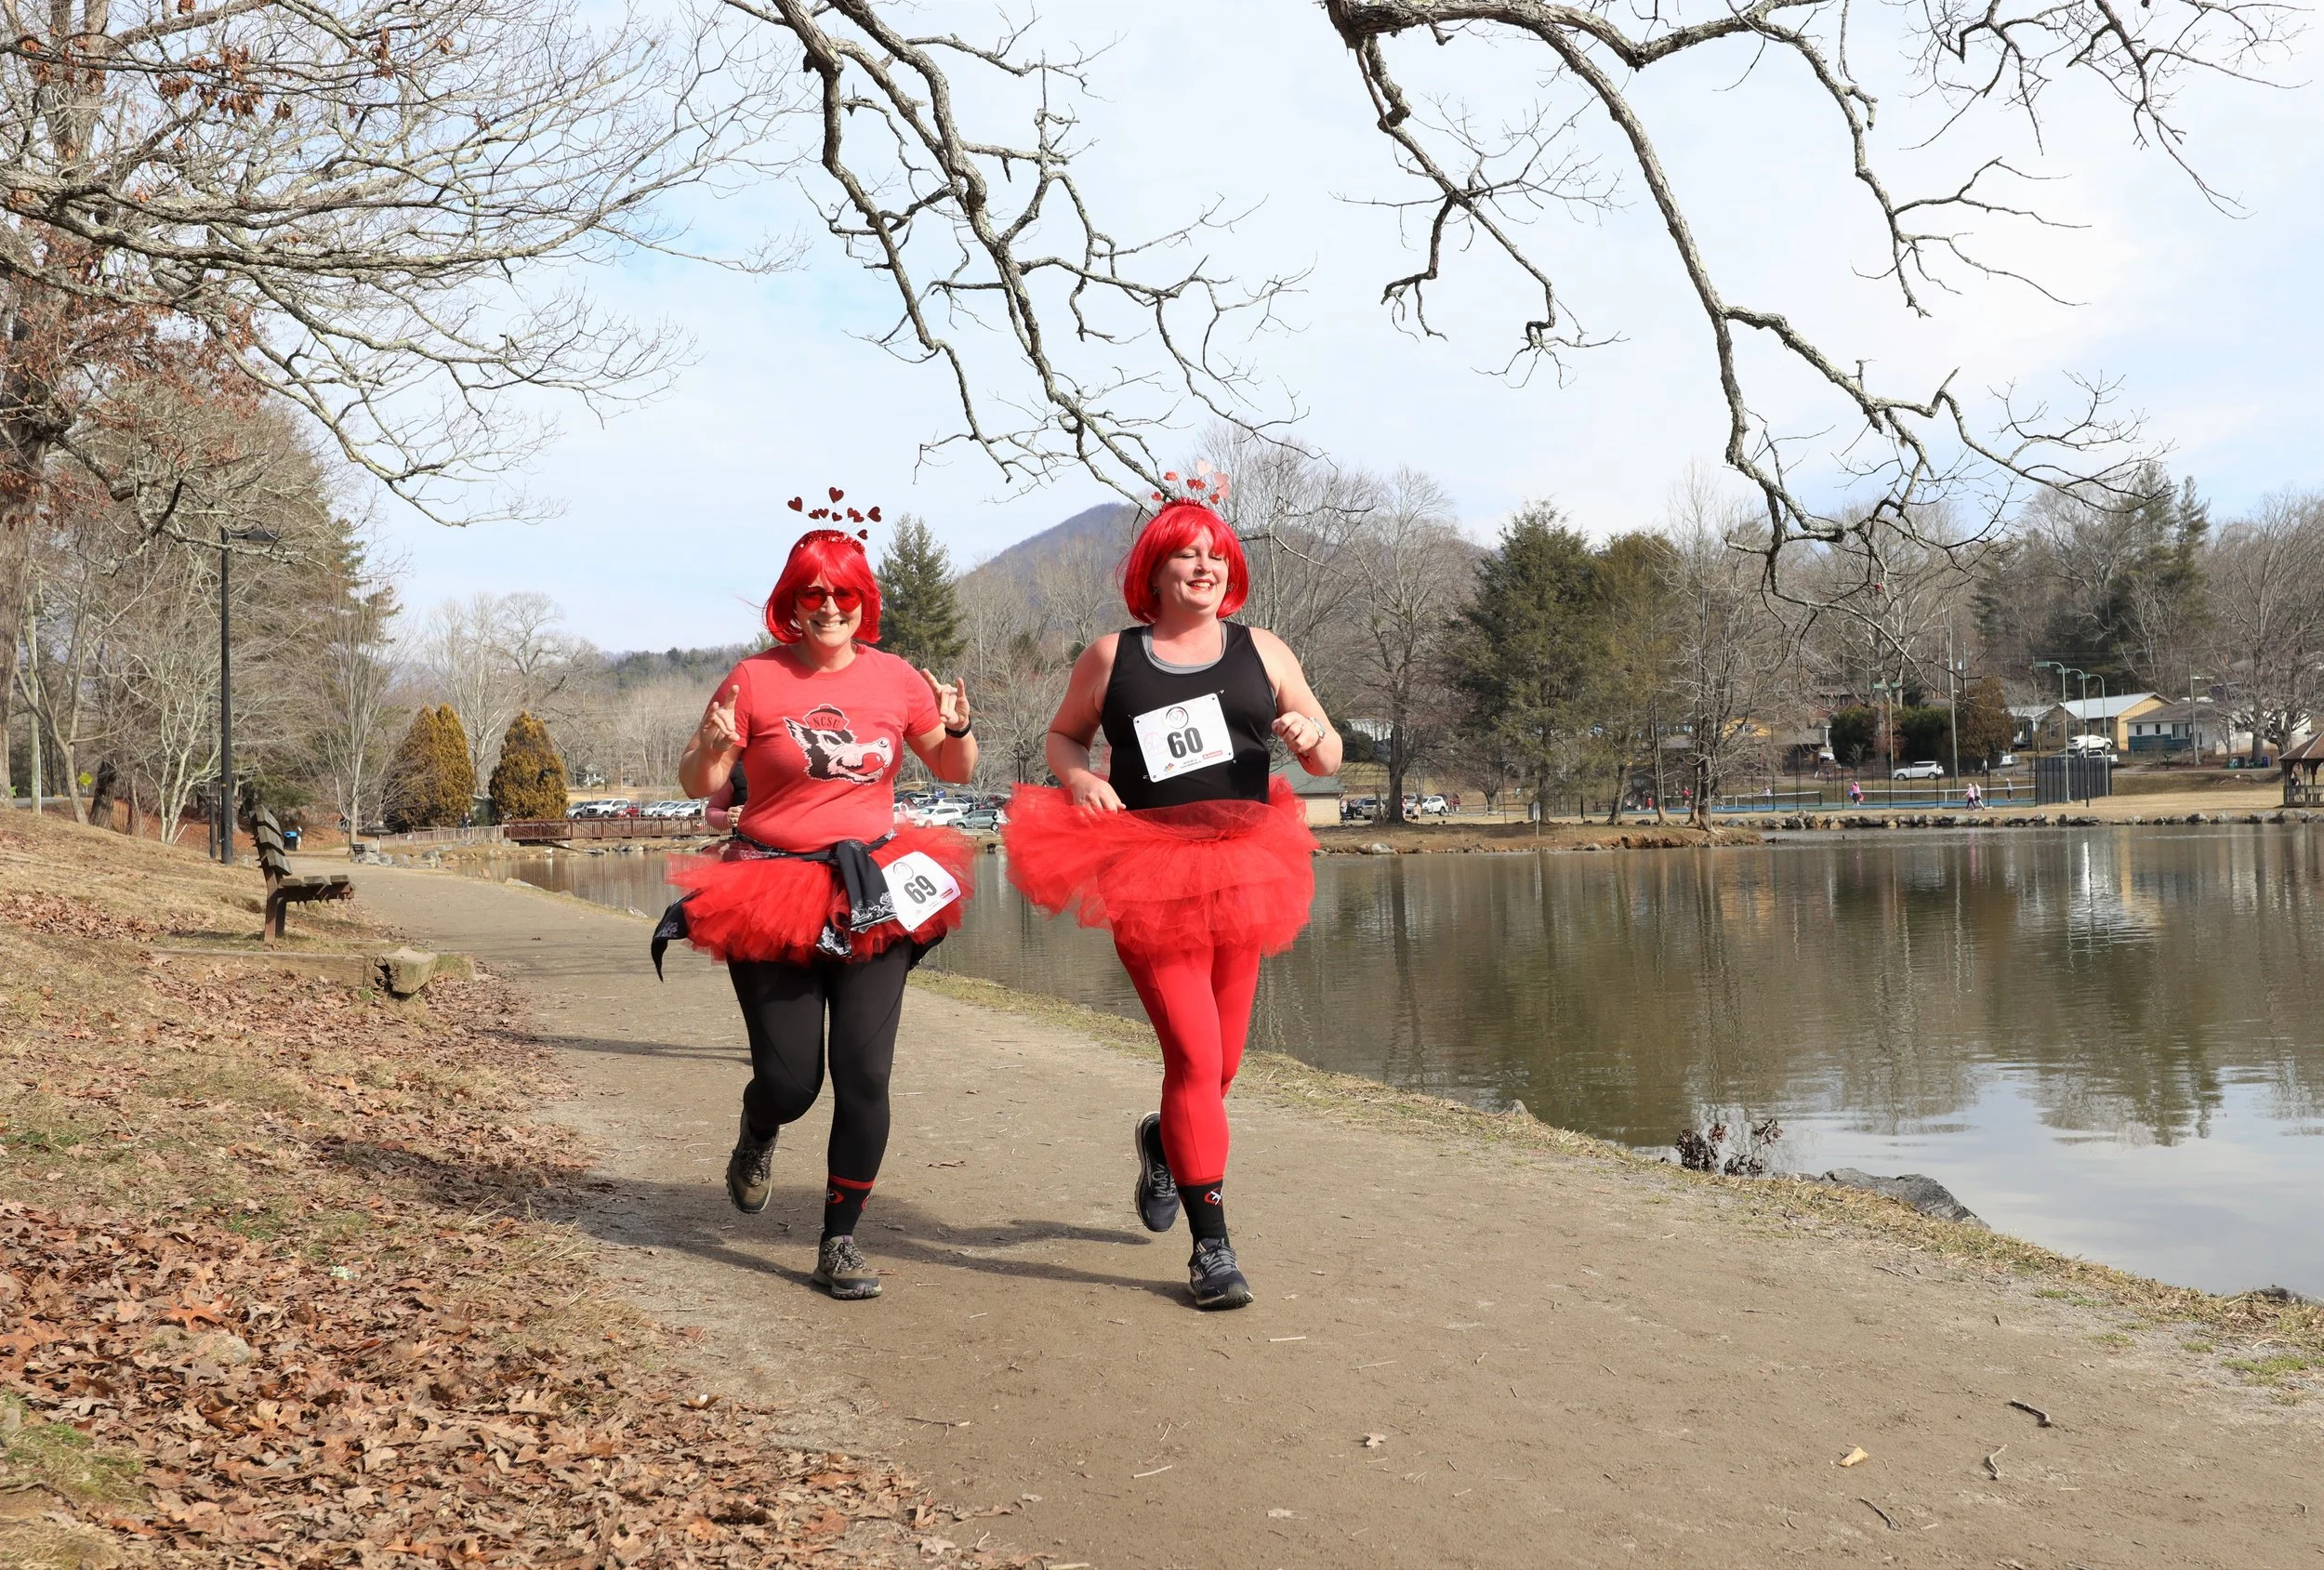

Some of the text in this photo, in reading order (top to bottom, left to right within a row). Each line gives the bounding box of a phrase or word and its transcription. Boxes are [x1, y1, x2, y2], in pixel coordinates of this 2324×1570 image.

[812, 716, 840, 729] NCSU
[1168, 727, 1204, 759] 60
[904, 875, 937, 904] 69
